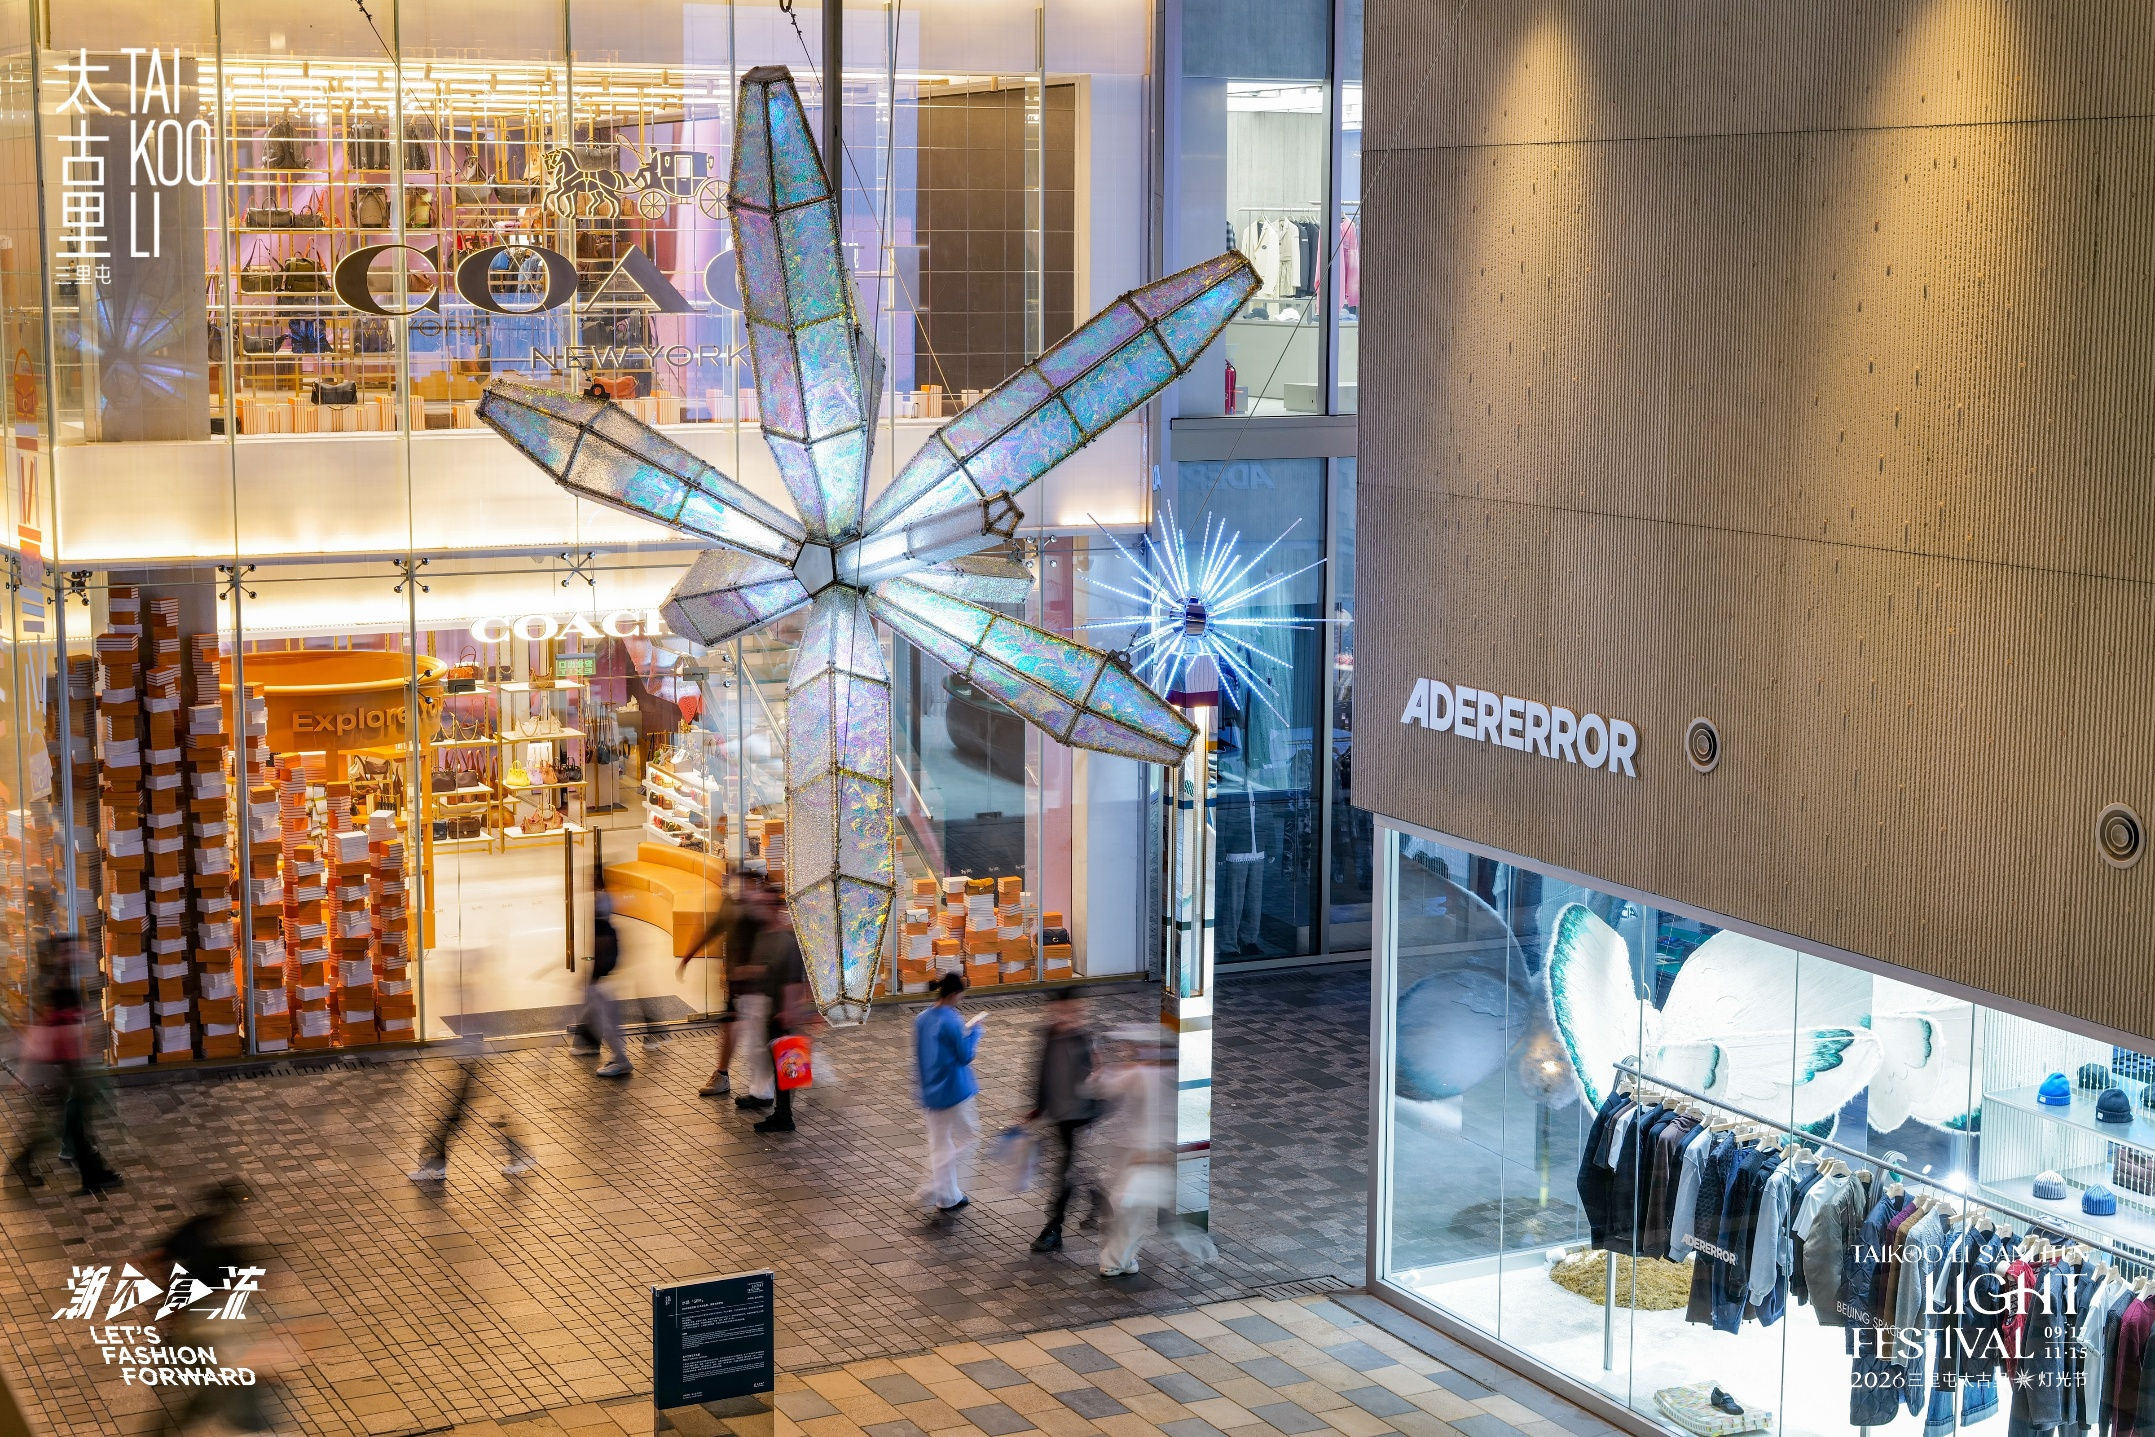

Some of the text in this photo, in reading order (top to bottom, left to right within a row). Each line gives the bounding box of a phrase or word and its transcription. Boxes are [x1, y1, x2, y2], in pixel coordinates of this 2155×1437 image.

[530, 344, 753, 369] NEW YORK
[292, 706, 406, 736] Explore
[1400, 677, 1639, 778] ADERERROR
[1681, 1233, 1737, 1266] ADERERROR
